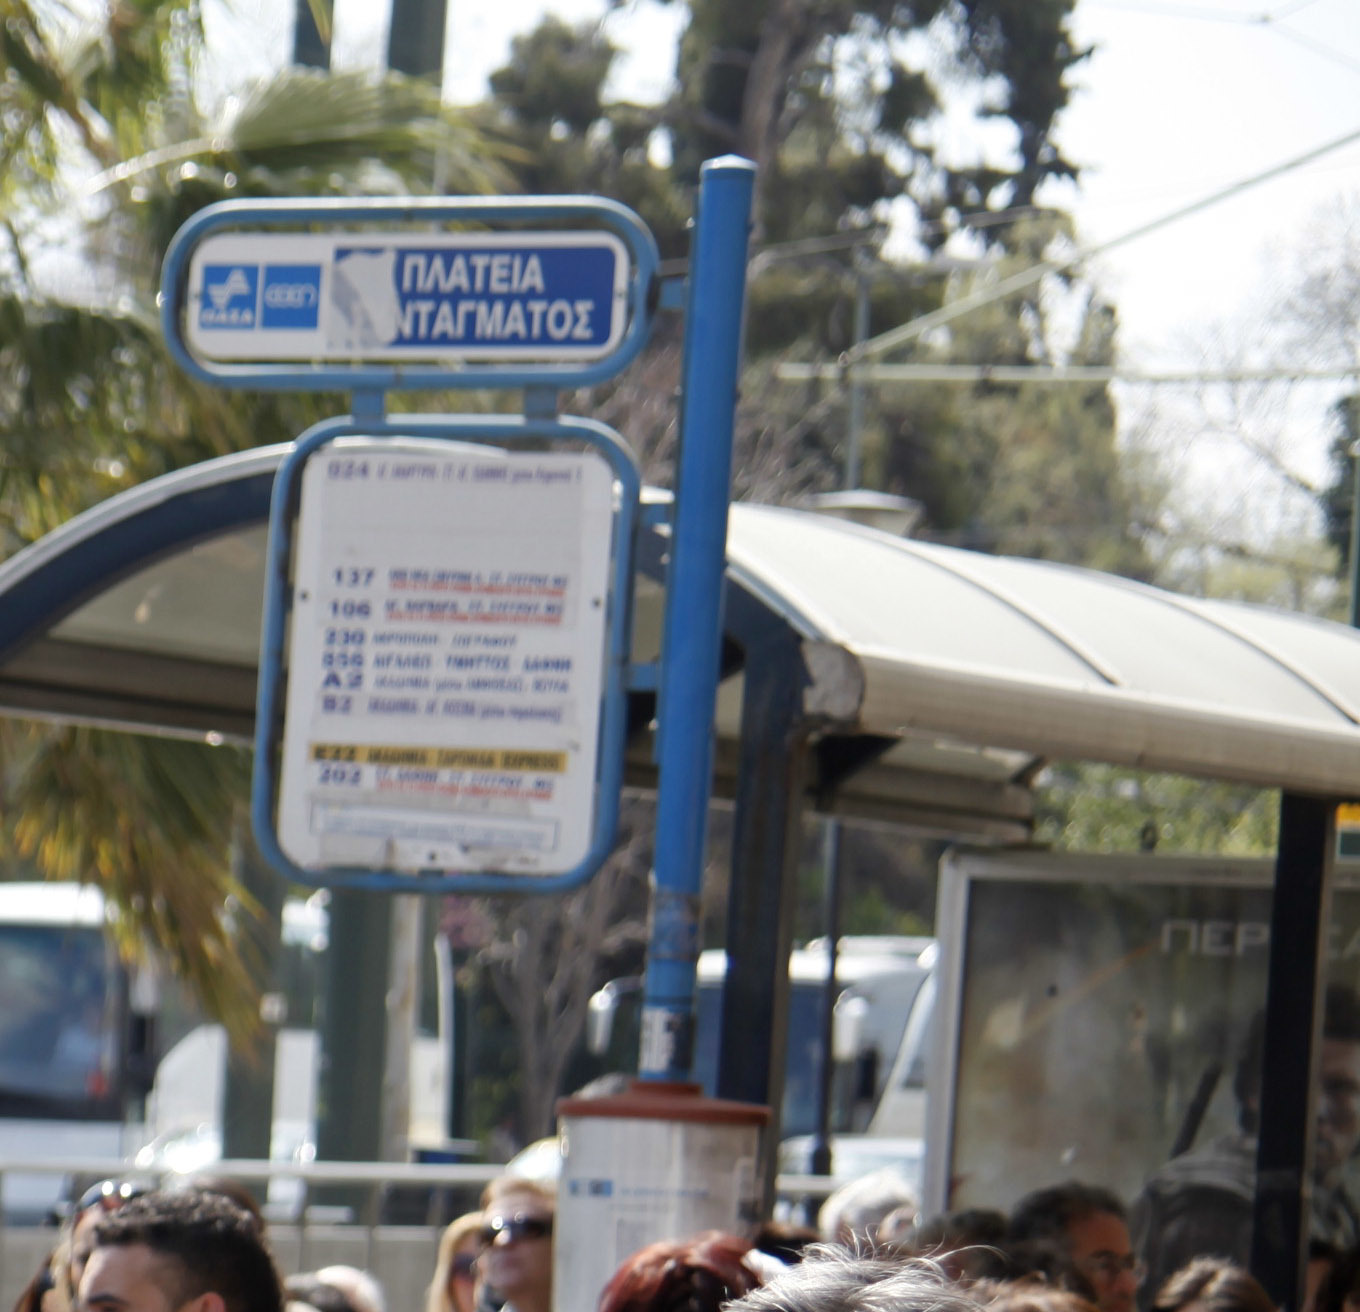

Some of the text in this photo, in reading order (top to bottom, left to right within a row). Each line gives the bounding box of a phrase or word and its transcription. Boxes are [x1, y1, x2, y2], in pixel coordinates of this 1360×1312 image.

[402, 253, 545, 293] ΠΛΑΤΕΙΑ
[397, 299, 595, 341] ΝΤΑΓΜΑΤΟΣ
[333, 567, 375, 588] 137
[330, 599, 372, 620] 106
